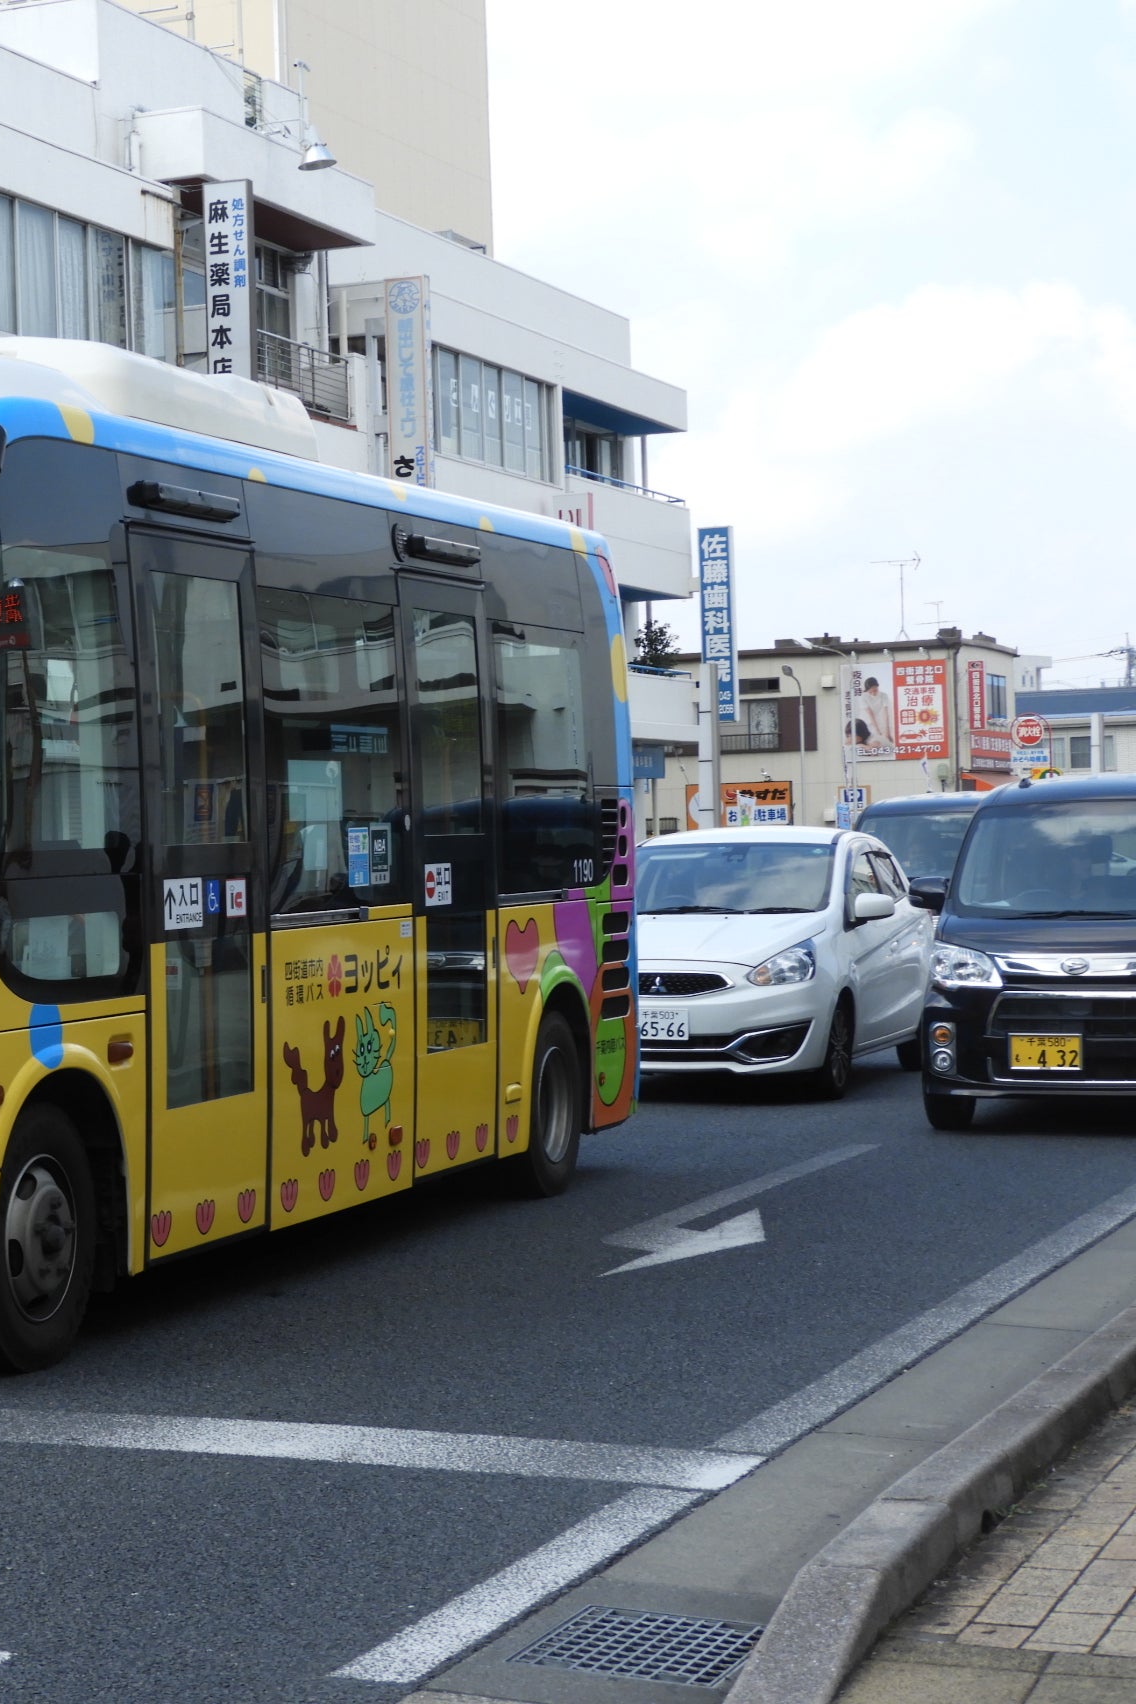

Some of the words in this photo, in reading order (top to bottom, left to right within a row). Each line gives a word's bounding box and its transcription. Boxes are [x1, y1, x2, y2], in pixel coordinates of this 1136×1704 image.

[1017, 726, 1042, 738] 消火栓
[728, 807, 787, 823] お駐車場
[435, 866, 451, 886] 出口
[573, 858, 594, 883] 1190
[178, 882, 199, 907] 入口
[437, 890, 449, 902] EXIT
[176, 911, 202, 924] ENTRANCE
[284, 957, 324, 981] 四街道市内
[344, 945, 403, 994] ヨッピィ
[285, 983, 324, 1007] 循環バス
[640, 1021, 686, 1038] 65-66
